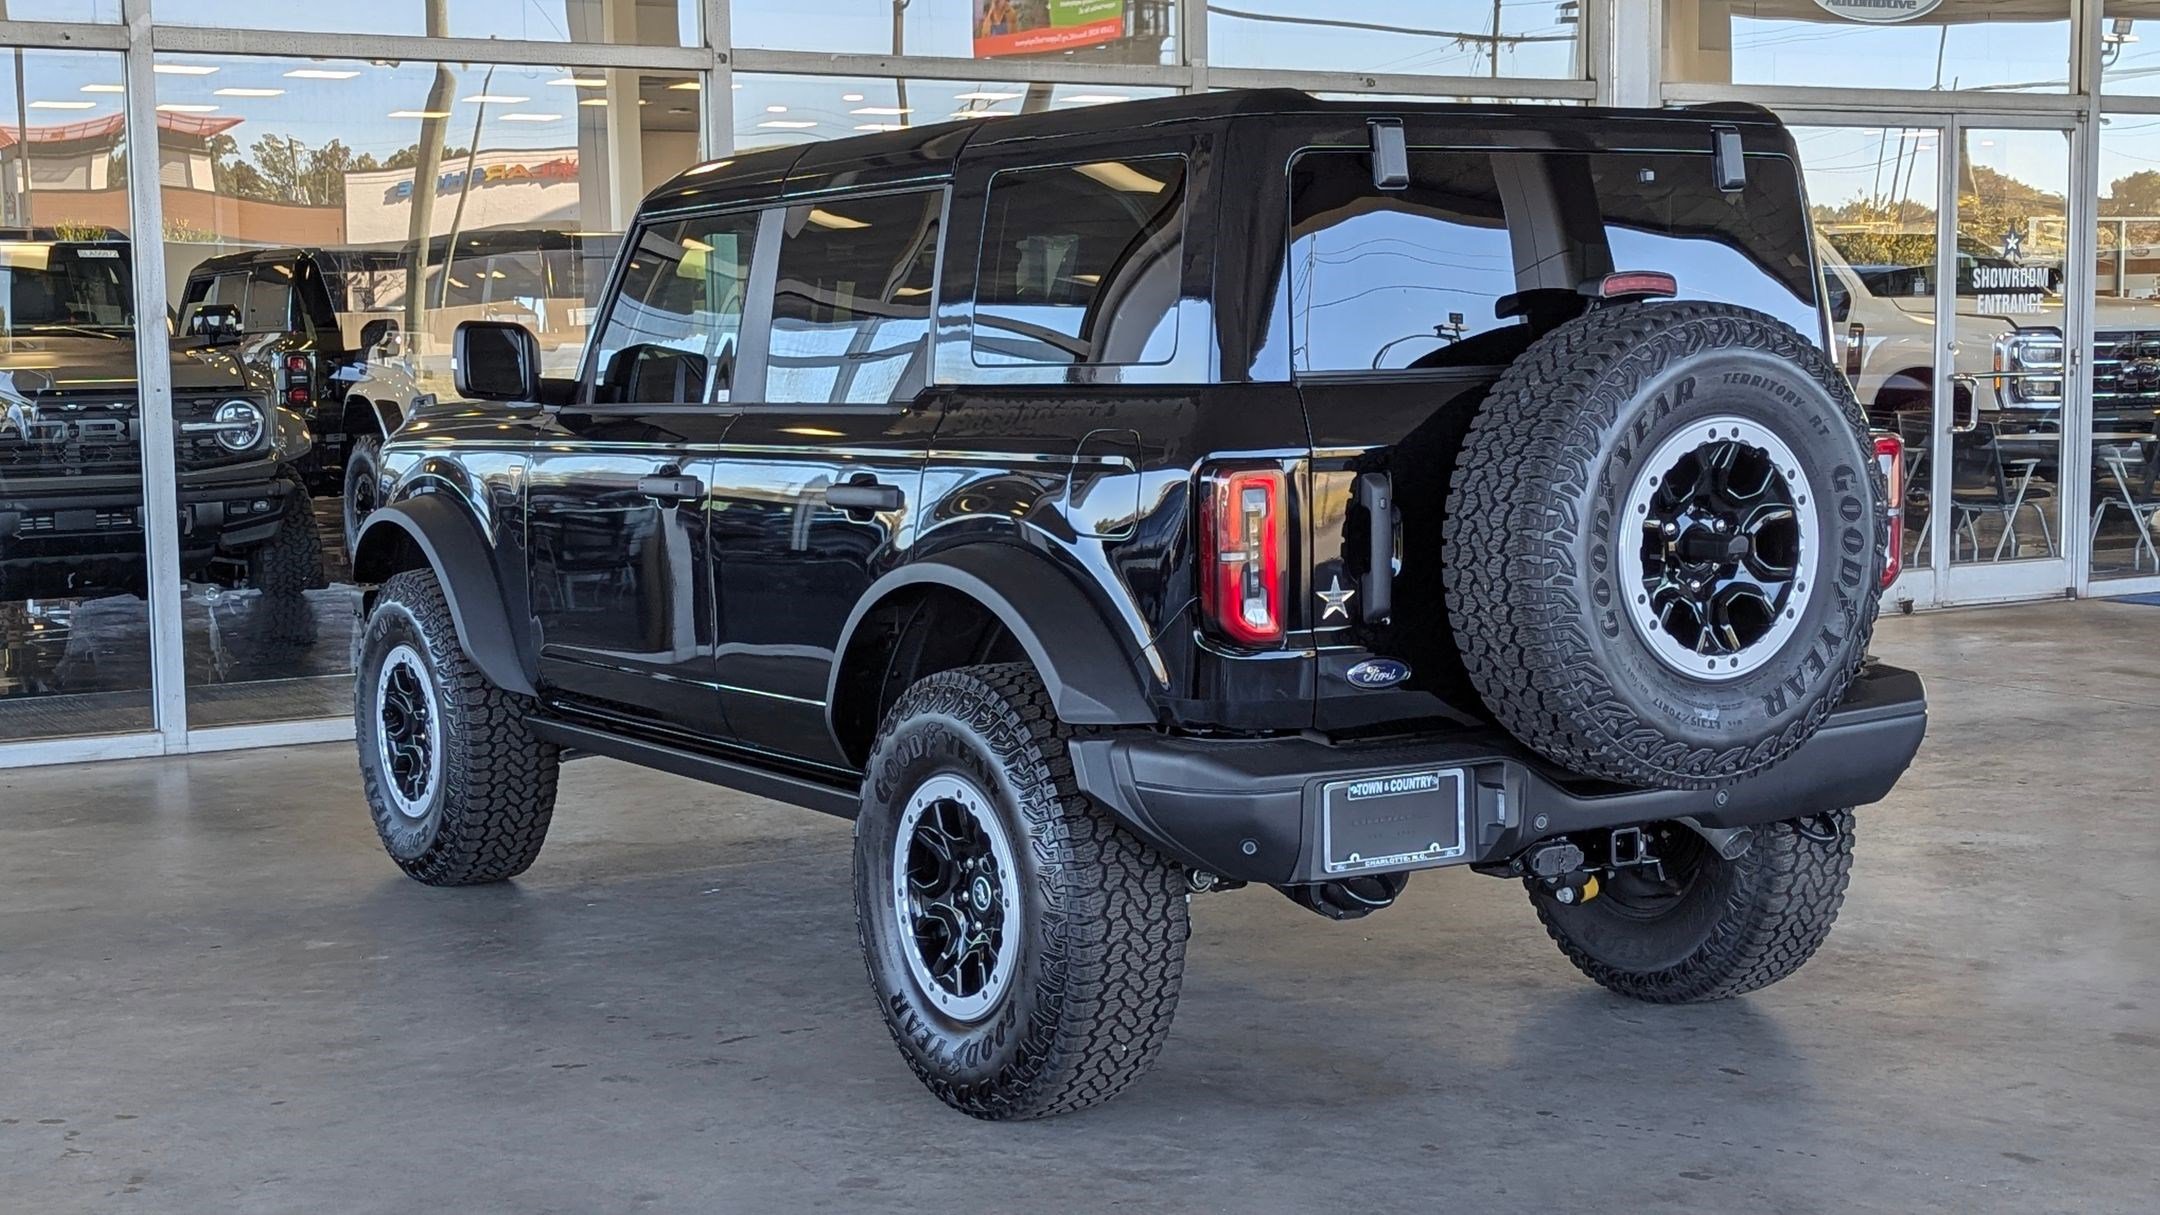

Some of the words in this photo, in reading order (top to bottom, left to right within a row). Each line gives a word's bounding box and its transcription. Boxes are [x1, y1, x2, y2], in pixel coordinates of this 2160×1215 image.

[1972, 267, 2049, 289] SHOWROOM
[1977, 293, 2044, 315] ENTRANCE
[1722, 373, 1806, 408] TERRITORY
[1809, 414, 1831, 436] RT
[1591, 376, 1696, 638] GOODYEAR
[1763, 464, 1865, 718] GOODYEAR
[1357, 780, 1383, 796] TOWN
[1384, 781, 1390, 792] &
[1390, 774, 1432, 792] COUNTRY
